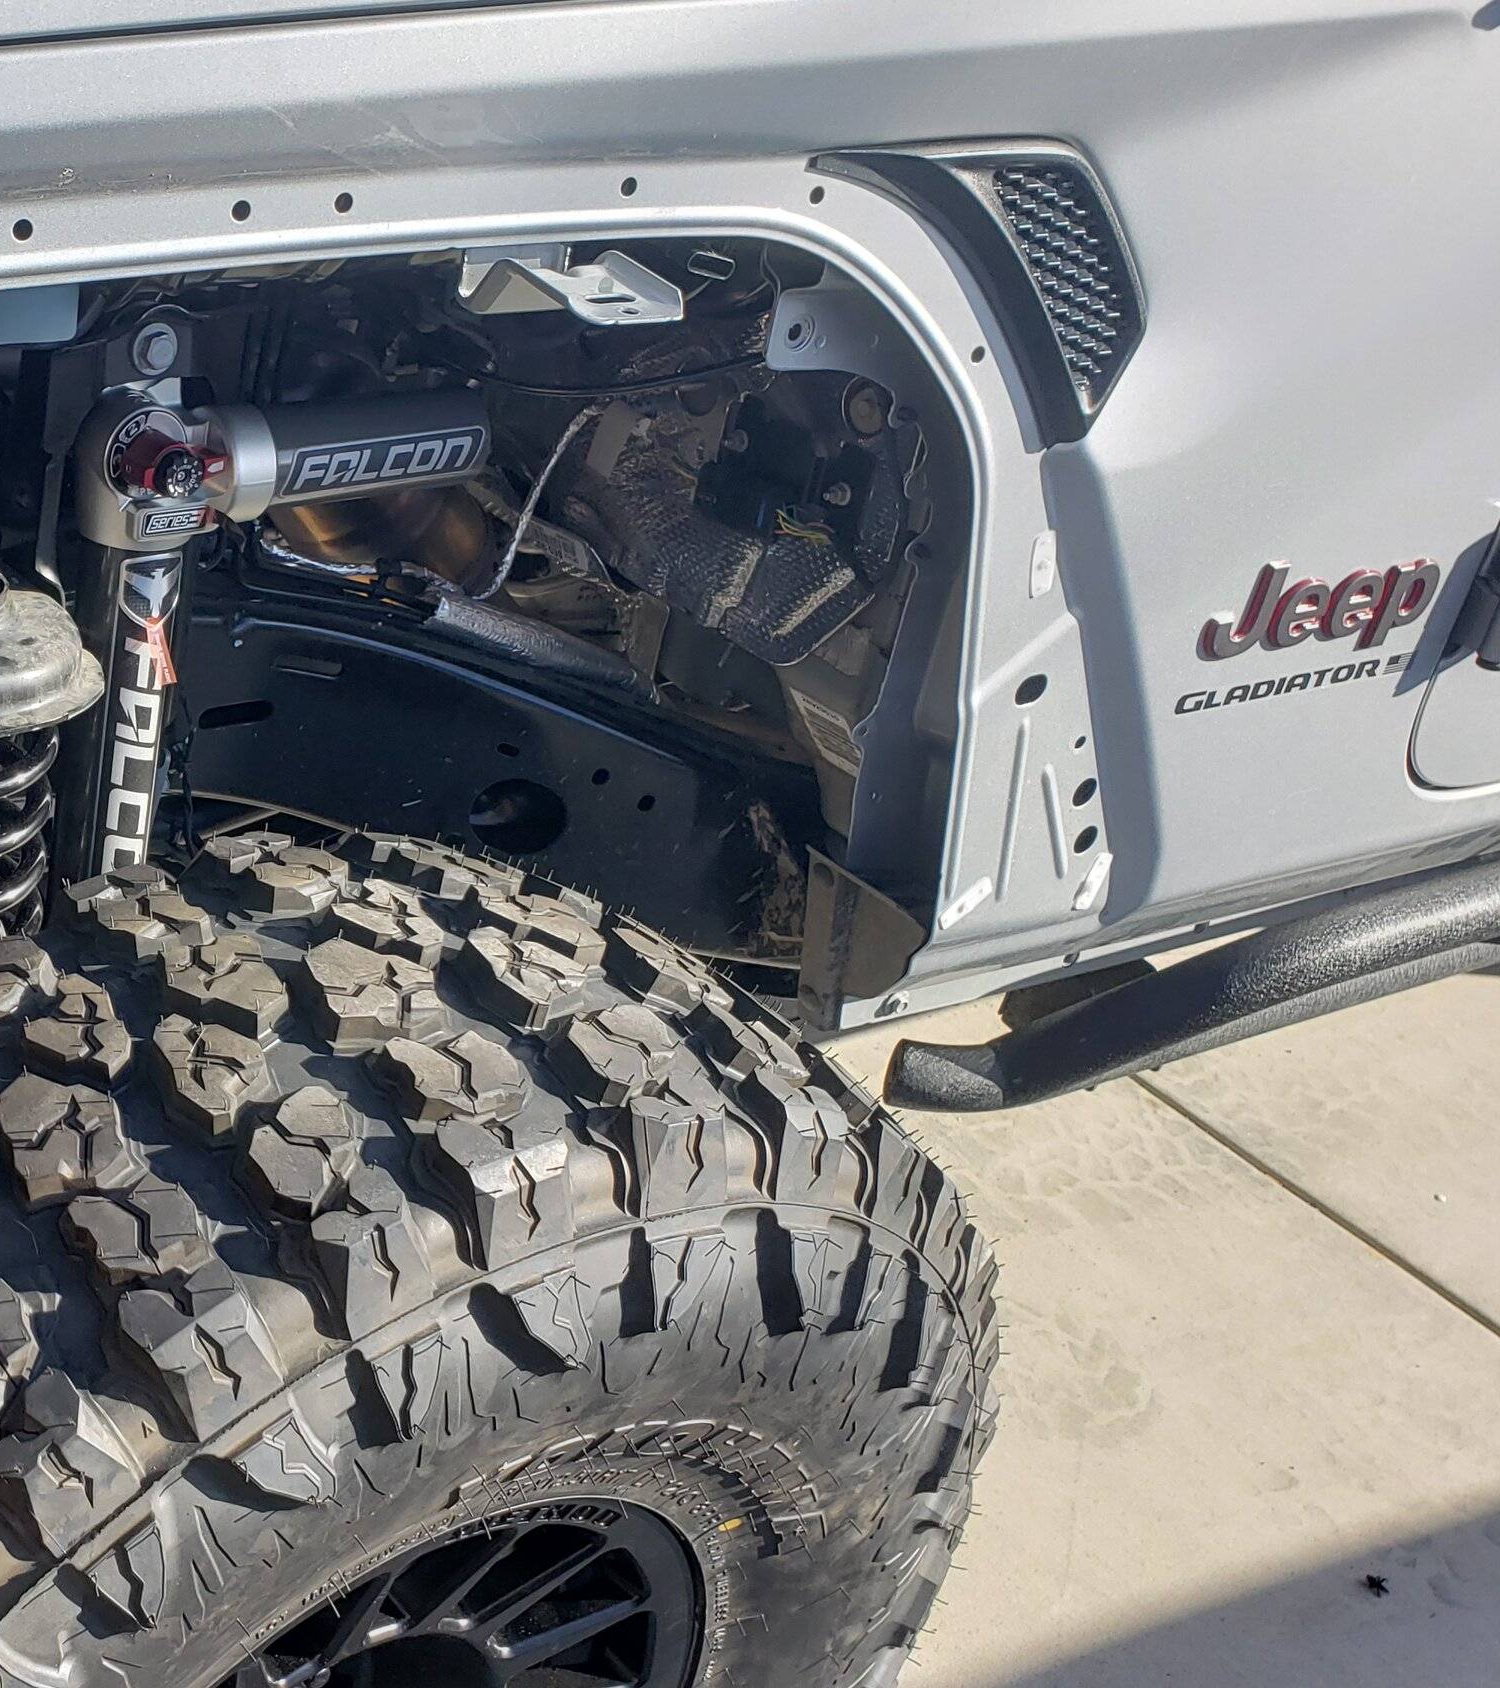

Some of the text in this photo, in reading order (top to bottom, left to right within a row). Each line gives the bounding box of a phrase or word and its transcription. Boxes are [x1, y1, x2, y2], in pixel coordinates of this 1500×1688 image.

[294, 434, 473, 490] FALCON
[1196, 557, 1441, 662] Jeep
[1174, 658, 1380, 715] GLADIATOR
[101, 636, 165, 874] FALCO
